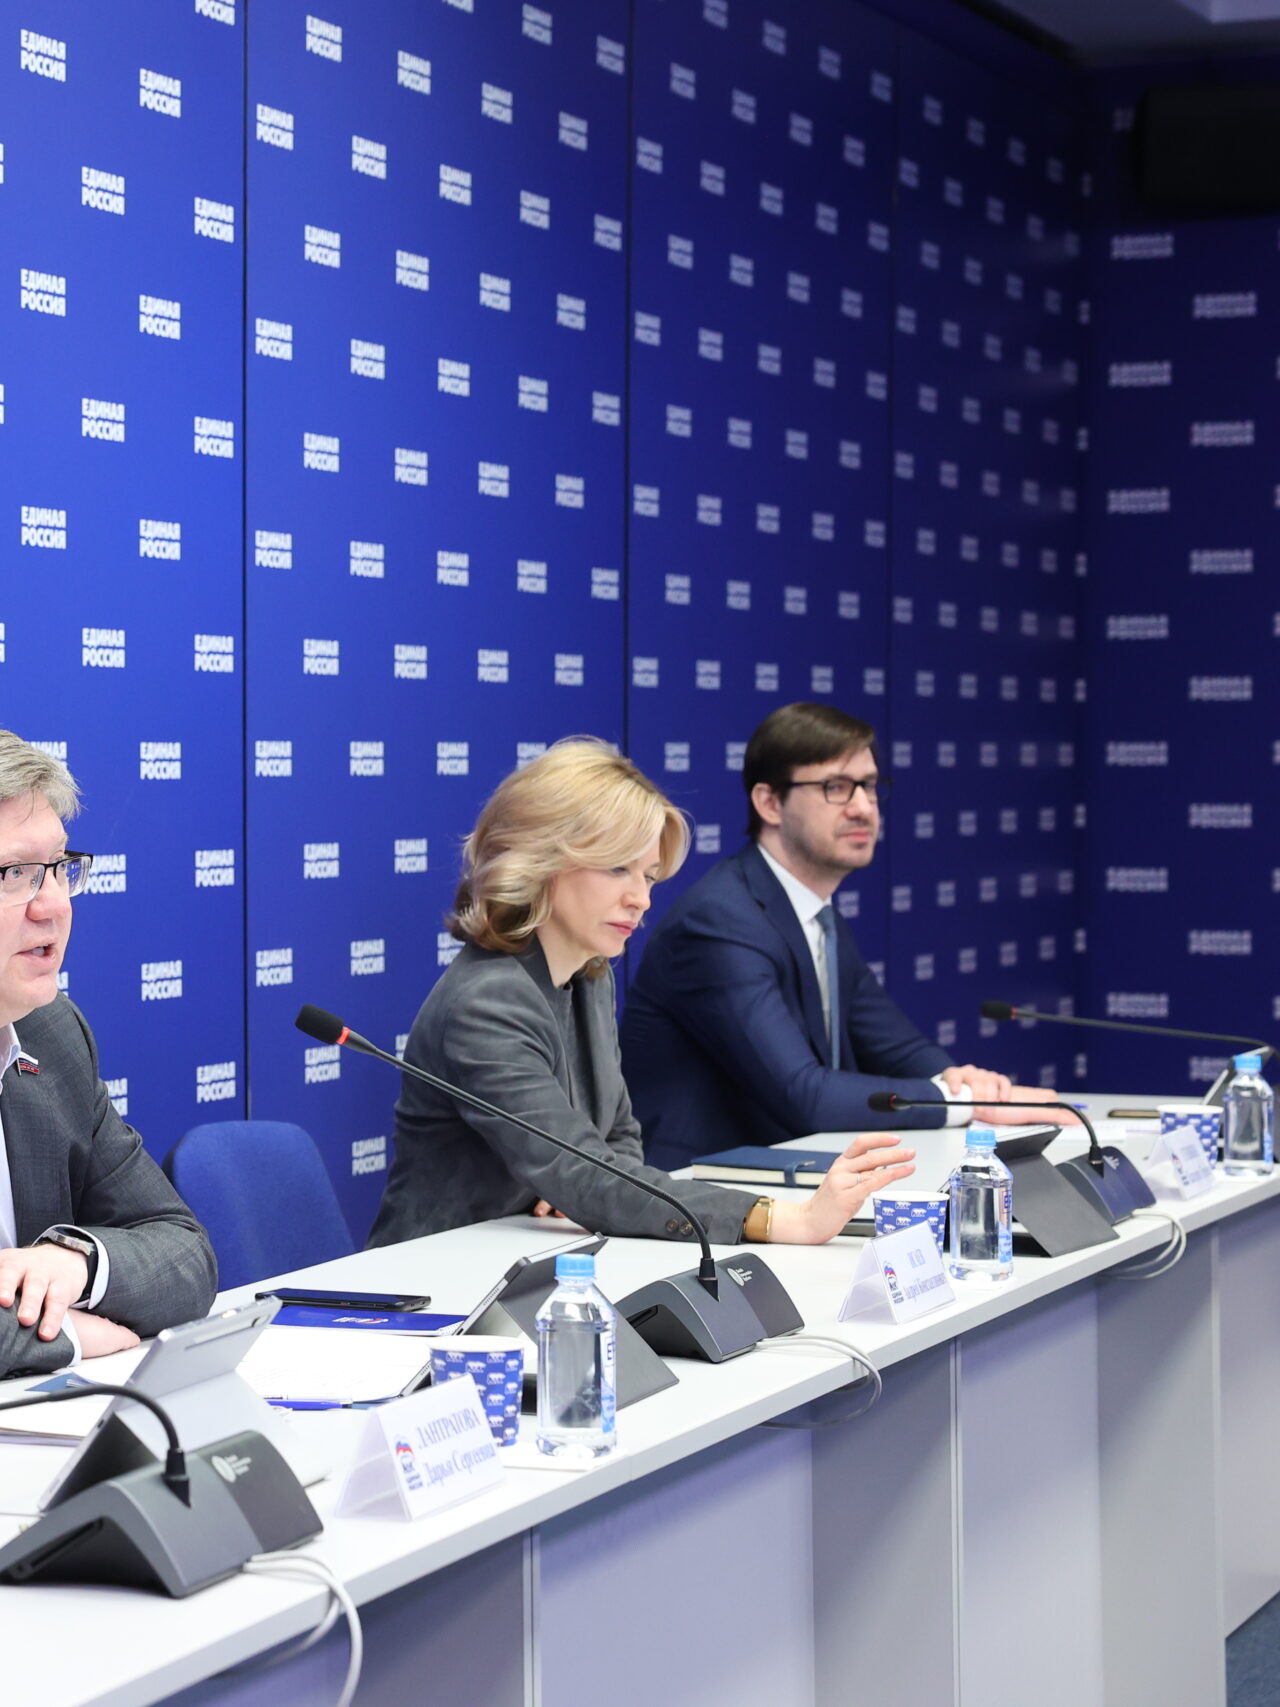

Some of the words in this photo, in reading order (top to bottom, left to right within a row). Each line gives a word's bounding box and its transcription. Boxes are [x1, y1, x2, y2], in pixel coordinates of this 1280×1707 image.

[21, 29, 66, 60] ЕДИНАЯ
[21, 50, 66, 82] РОССИЯ
[140, 69, 181, 97] ЕДИНАЯ
[140, 88, 181, 117] РОССИЯ
[82, 167, 124, 194] ЕДИНАЯ
[82, 186, 124, 215] РОССИЯ
[195, 197, 234, 223] ЕДИНАЯ
[195, 216, 234, 243] РОССИЯ
[21, 269, 65, 295] ЕДИНАЯ
[21, 289, 65, 316] РОССИЯ
[140, 295, 180, 319] ЕДИНАЯ
[140, 314, 180, 339] РОССИЯ
[82, 398, 124, 421] ЕДИНАЯ
[82, 417, 124, 442] РОССИЯ
[194, 417, 233, 438] ЕДИНАЯ
[194, 435, 233, 458] РОССИЯ
[21, 506, 66, 528] ЕДИНАЯ
[21, 526, 66, 549] РОССИЯ
[140, 519, 180, 540] ЕДИНАЯ
[140, 538, 180, 560] РОССИЯ
[82, 628, 125, 647] ЕДИНАЯ
[195, 634, 233, 653] ЕДИНАЯ
[82, 647, 125, 667] РОССИЯ
[195, 653, 233, 672] РОССИЯ
[140, 742, 181, 761] ЕДИНАЯ
[140, 761, 181, 779] РОССИЯ
[195, 849, 234, 868] ЕДИНАЯ
[195, 868, 234, 887] РОССИЯ
[141, 960, 182, 981] ЕДИНАЯ
[142, 979, 182, 1001] РОССИЯ
[197, 1062, 235, 1084] ЕДИНАЯ
[197, 1080, 235, 1103] РОССИЯ
